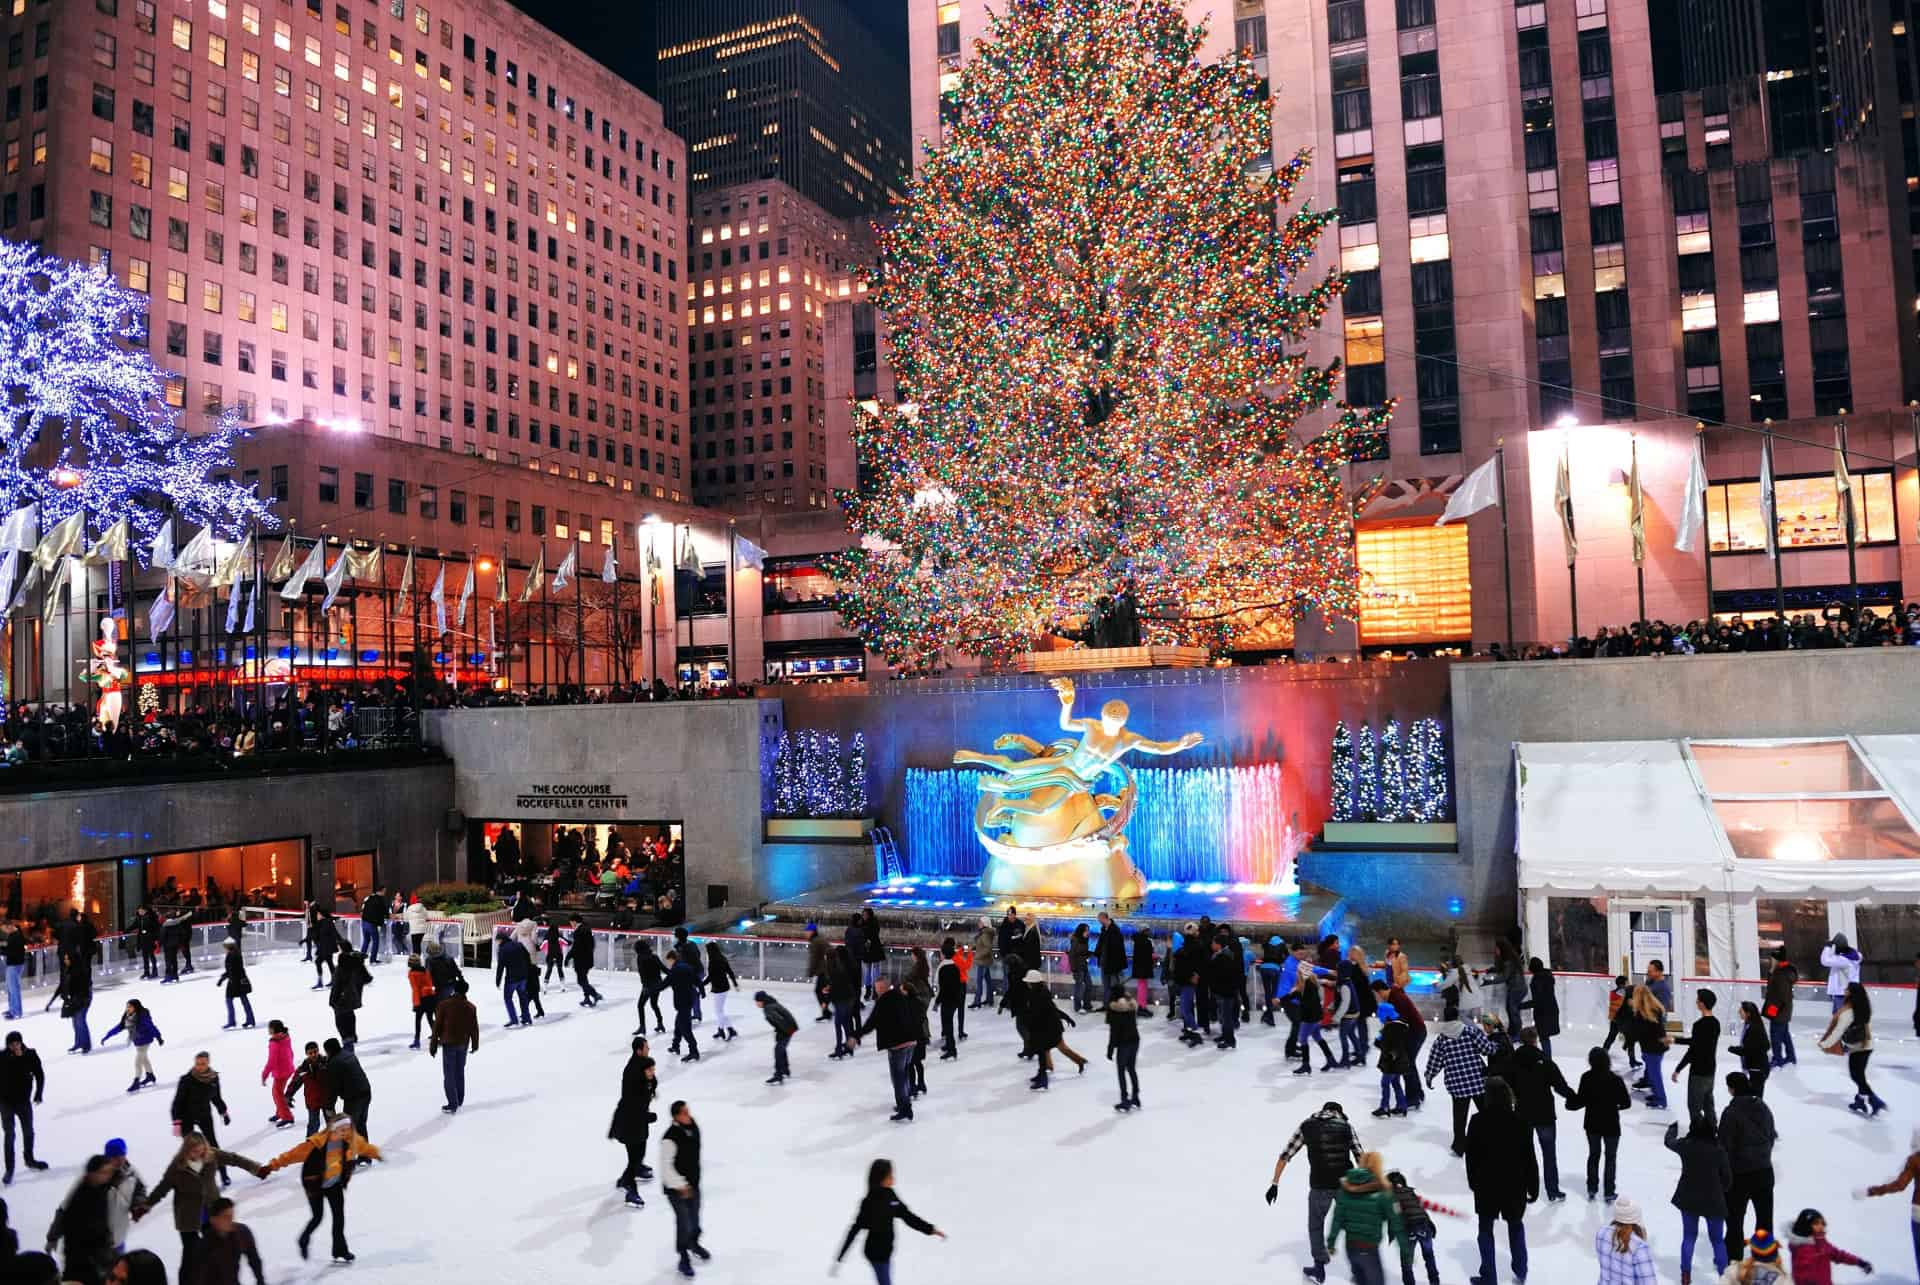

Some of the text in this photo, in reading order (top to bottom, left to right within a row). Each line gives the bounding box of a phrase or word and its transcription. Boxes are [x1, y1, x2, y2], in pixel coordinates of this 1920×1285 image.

[532, 784, 611, 794] THE CONCOURSE
[516, 799, 628, 809] ROCKEFELLER CENTER
